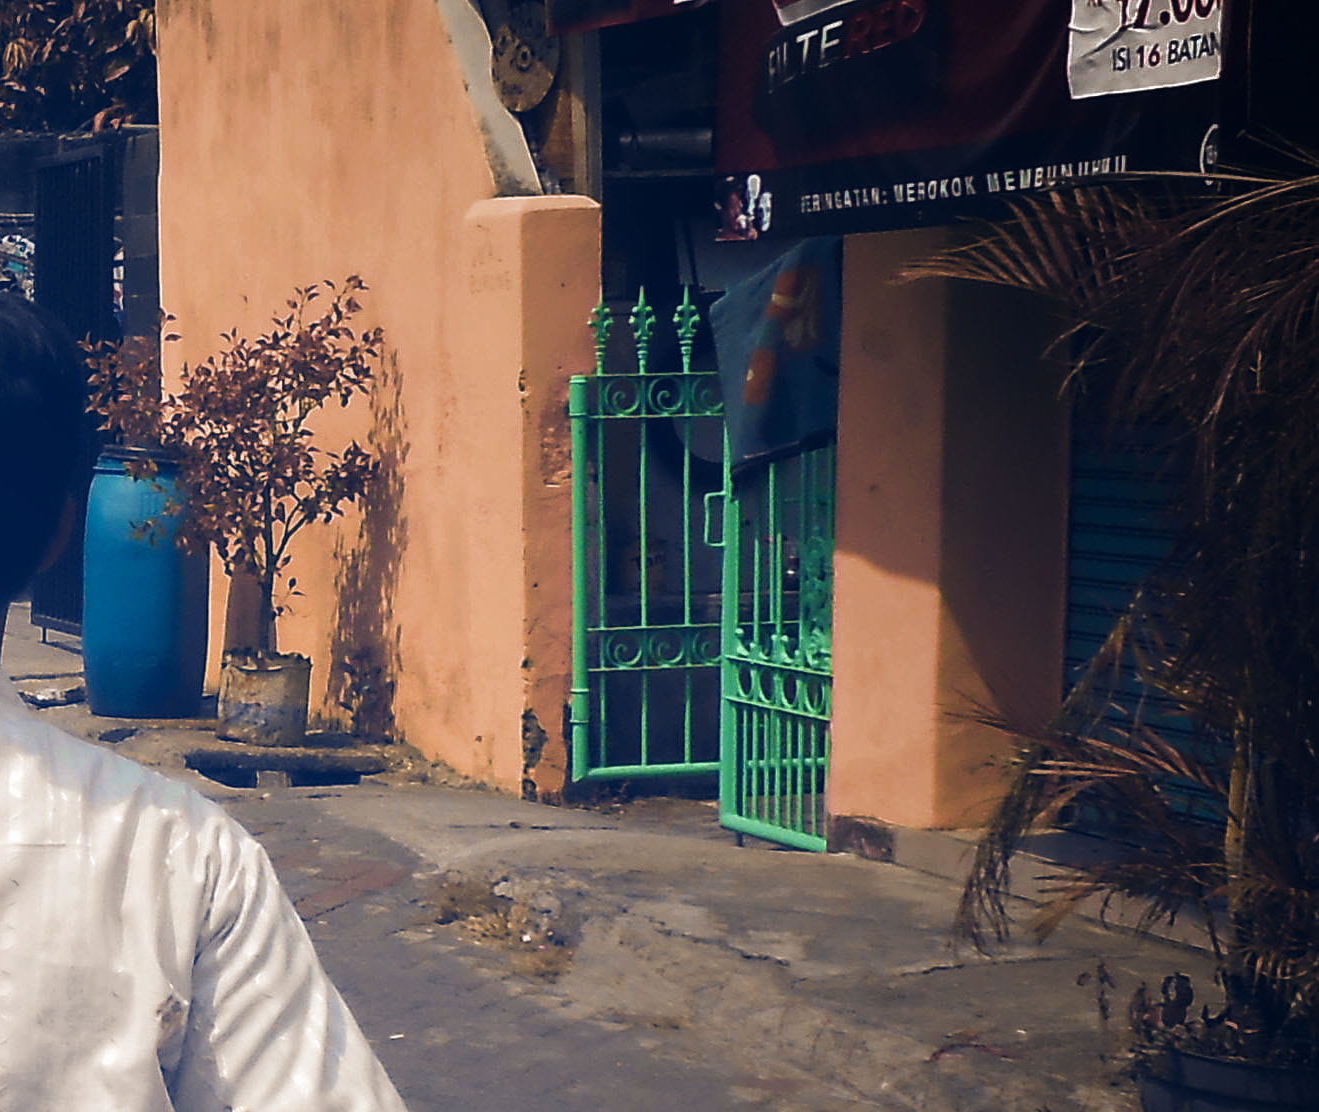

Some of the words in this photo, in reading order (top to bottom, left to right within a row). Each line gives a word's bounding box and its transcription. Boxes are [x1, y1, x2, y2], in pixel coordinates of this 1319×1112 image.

[1113, 48, 1132, 72] ISI
[1136, 43, 1161, 68] 16
[893, 175, 976, 203] MEROKOK
